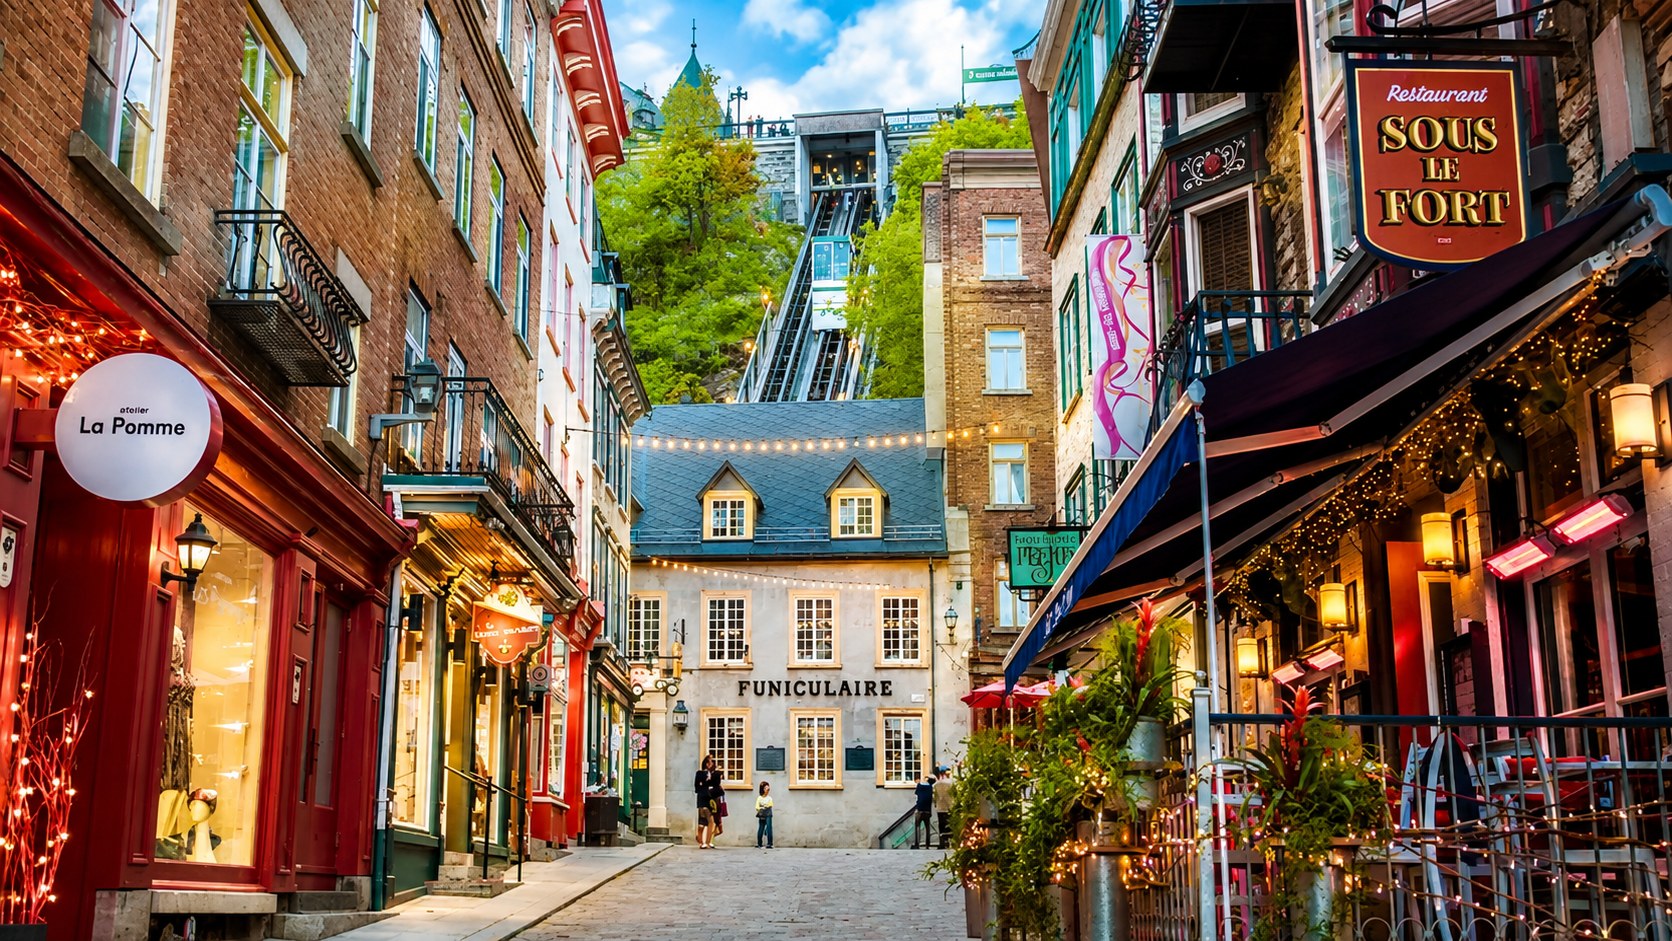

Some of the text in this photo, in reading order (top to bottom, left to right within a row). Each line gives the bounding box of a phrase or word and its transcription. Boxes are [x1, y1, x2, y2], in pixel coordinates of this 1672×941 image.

[1386, 84, 1489, 104] Restaurant
[1378, 115, 1499, 154] SOUS
[1422, 157, 1461, 183] LE
[1378, 188, 1511, 227] FORT
[119, 406, 150, 414] atelier
[79, 416, 186, 436] La Pomme
[738, 680, 893, 697] FUNICULAIRE
